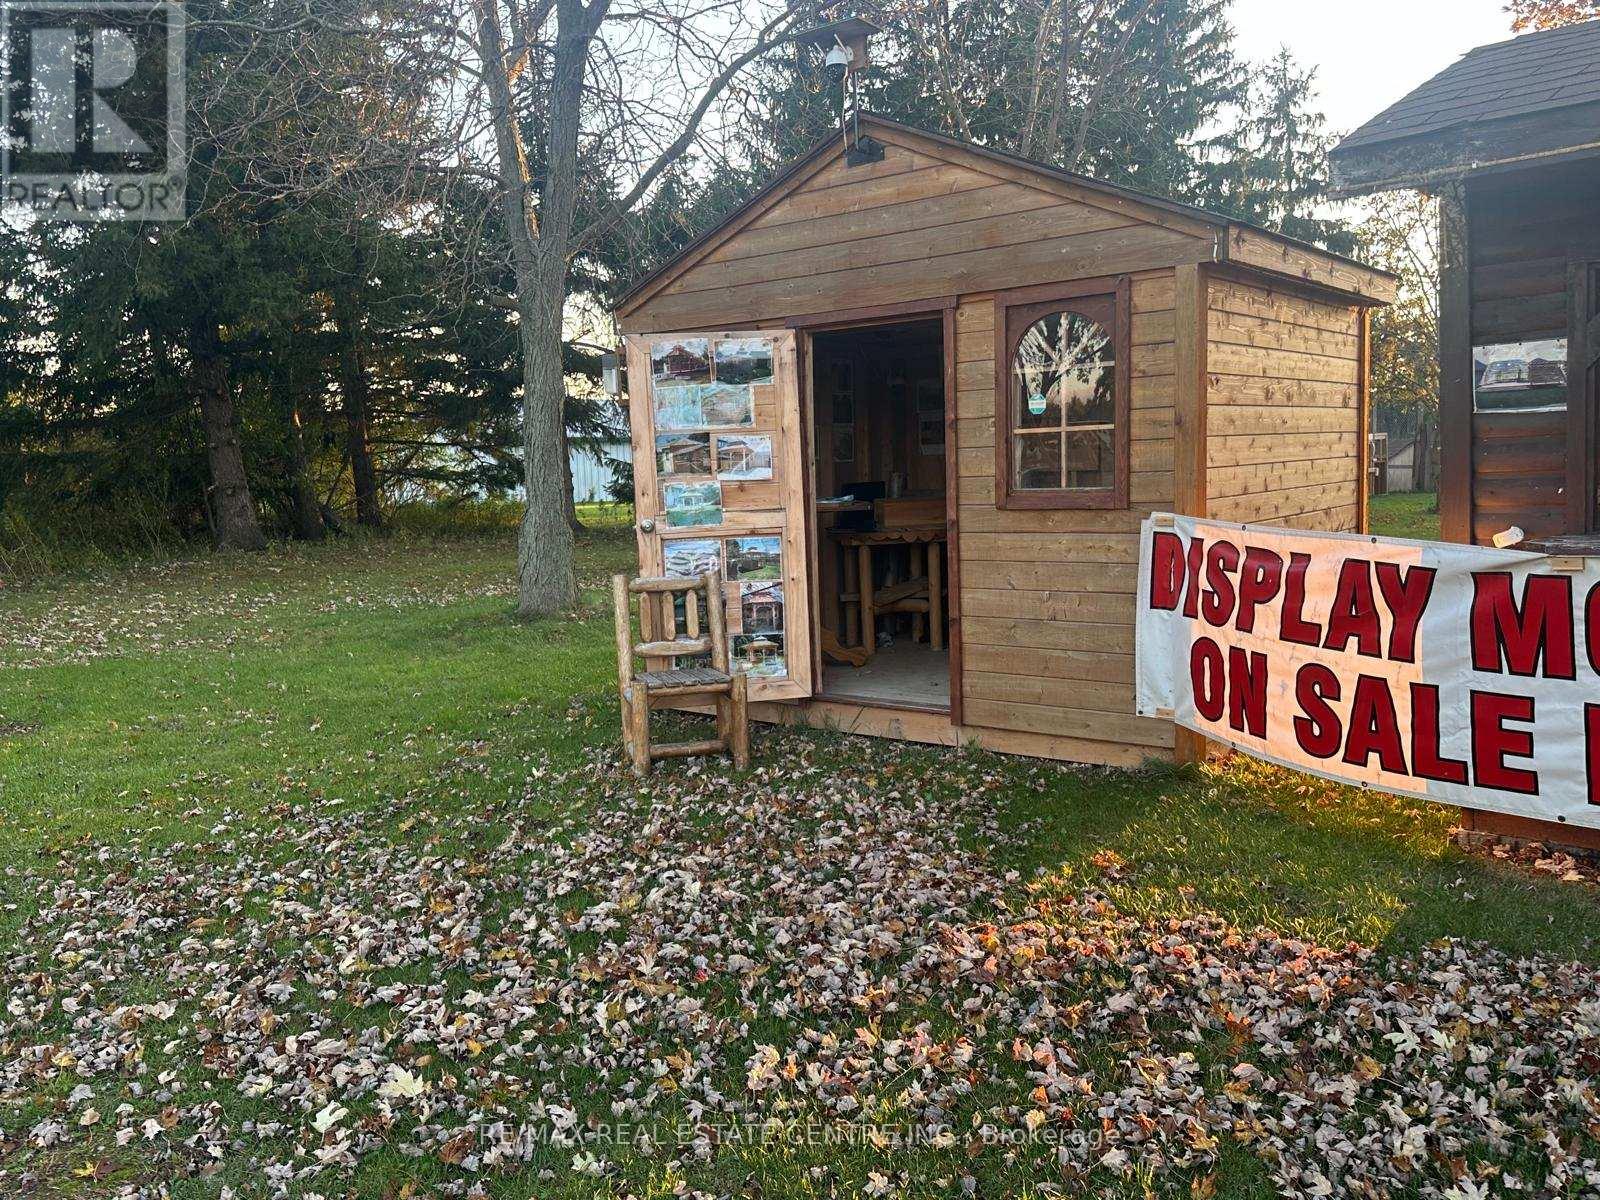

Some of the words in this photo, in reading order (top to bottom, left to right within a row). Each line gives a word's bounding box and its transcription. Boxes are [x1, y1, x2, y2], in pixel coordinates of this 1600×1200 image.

[1150, 531, 1437, 663] DISPLAY
[1470, 571, 1600, 681] M
[1190, 636, 1268, 740] ON
[1293, 663, 1539, 796] SALE
